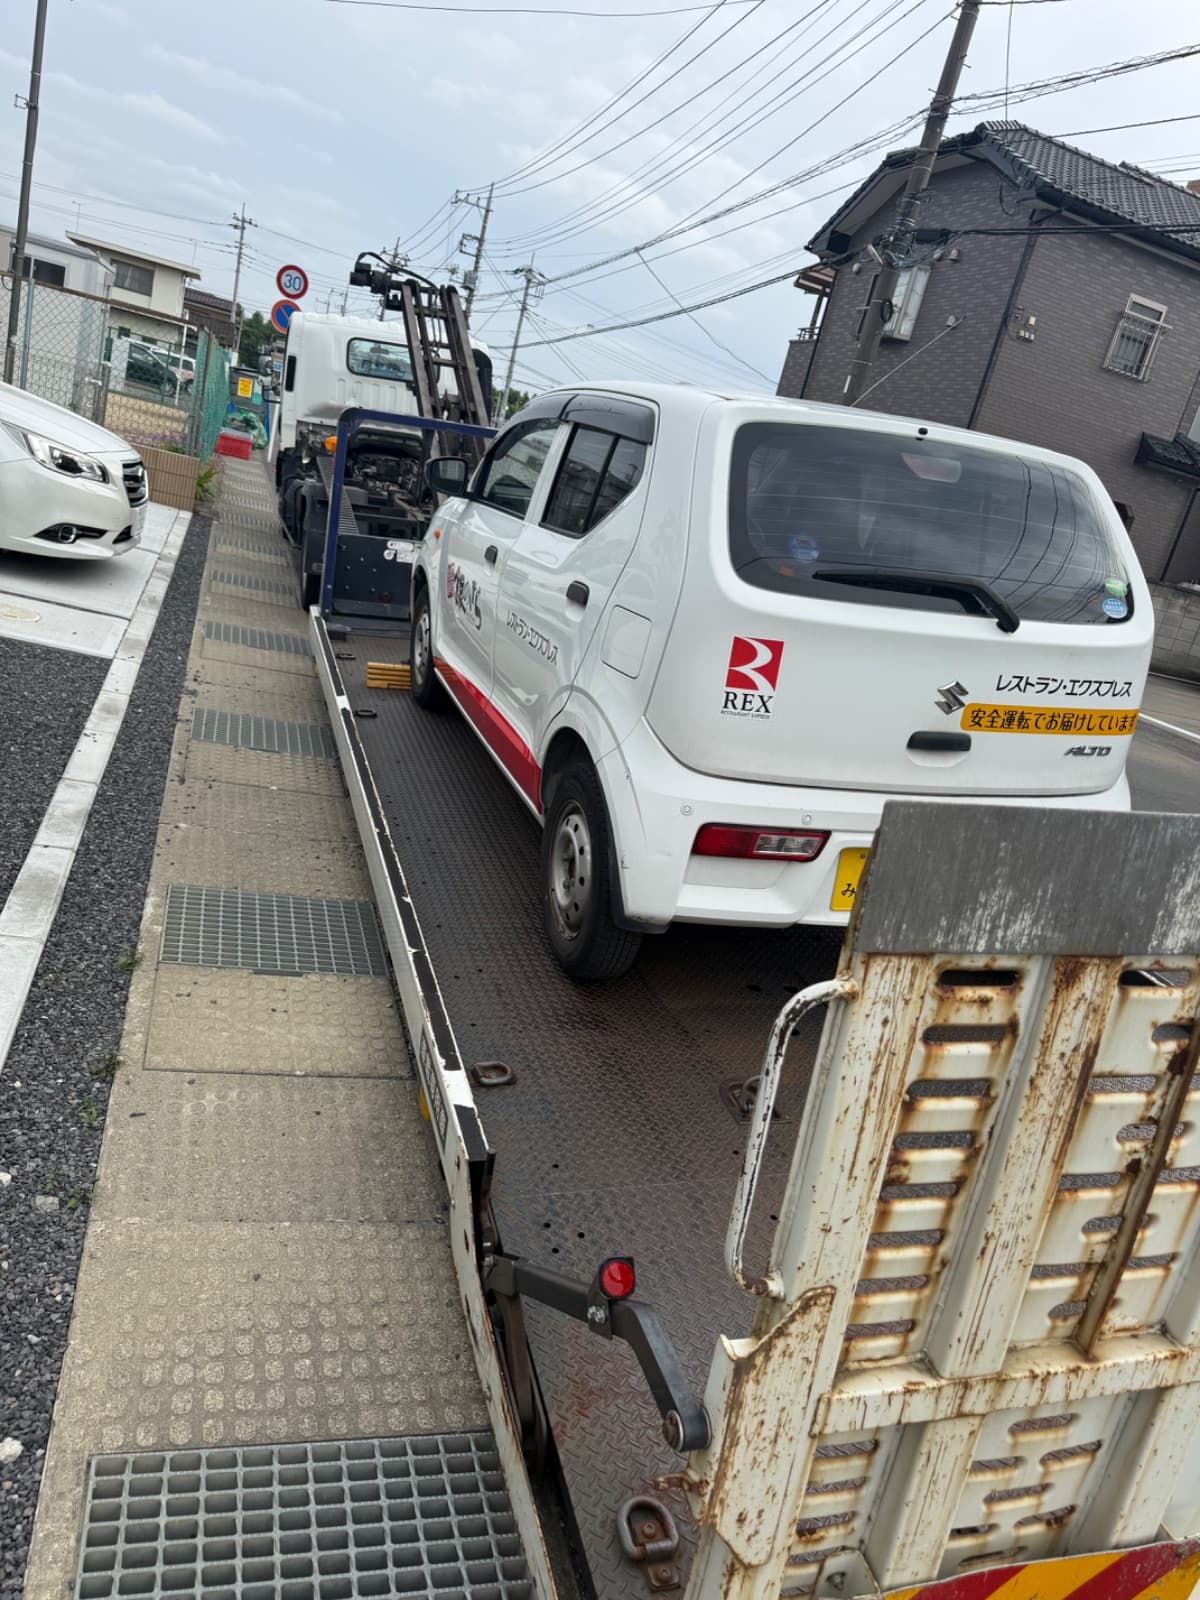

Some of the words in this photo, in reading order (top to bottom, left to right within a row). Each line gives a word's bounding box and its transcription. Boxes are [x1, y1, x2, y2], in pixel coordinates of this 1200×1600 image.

[283, 273, 302, 291] 30
[995, 674, 1133, 697] レストラン・エクスプレス
[722, 690, 774, 714] REX
